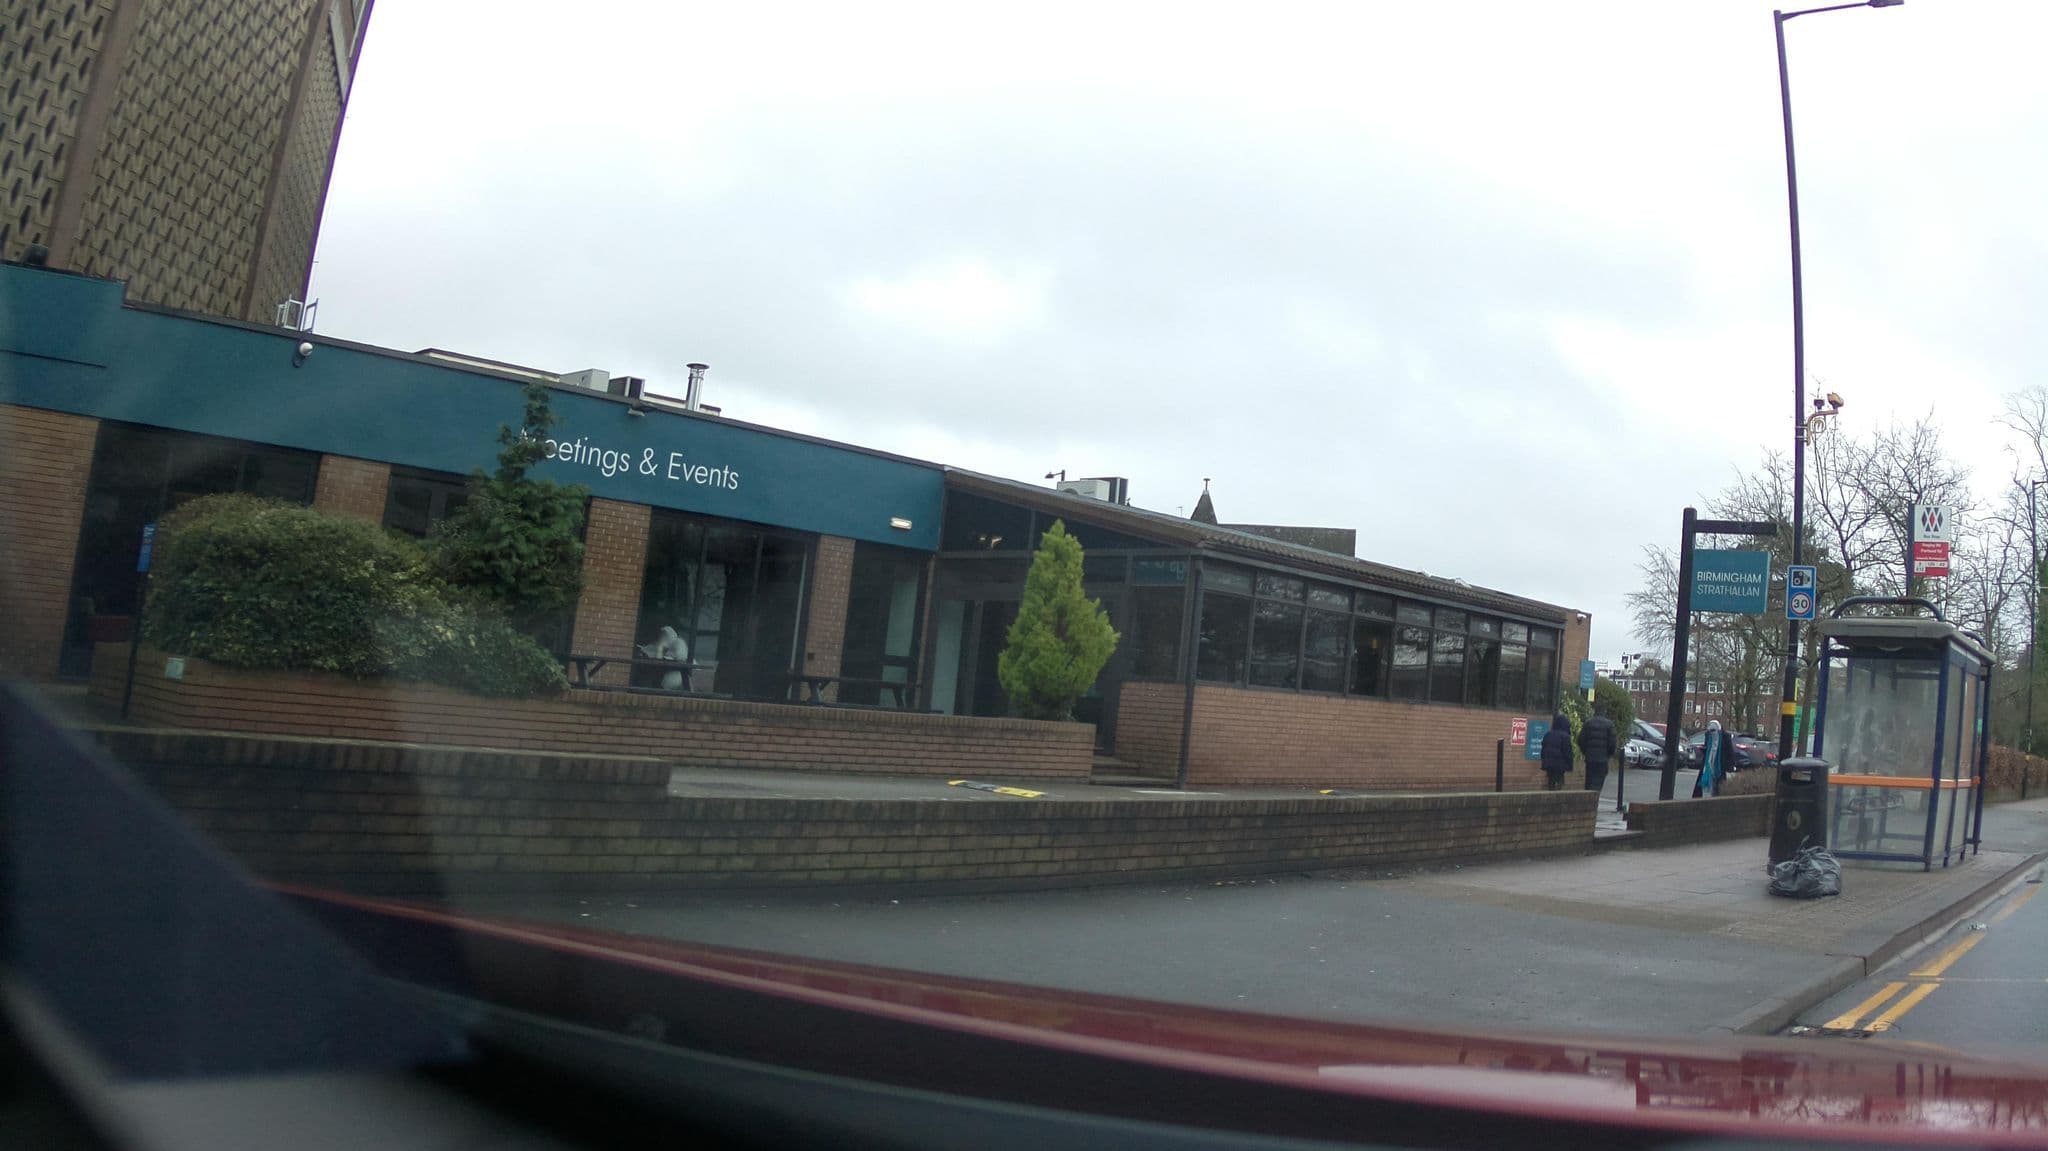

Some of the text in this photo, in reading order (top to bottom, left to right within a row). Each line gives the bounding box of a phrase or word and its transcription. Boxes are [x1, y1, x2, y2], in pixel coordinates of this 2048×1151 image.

[519, 427, 739, 490] eetings & Events
[1696, 571, 1762, 584] BIRMINGHAM
[1696, 584, 1760, 597] STRATHALLAN
[1793, 599, 1809, 609] 30
